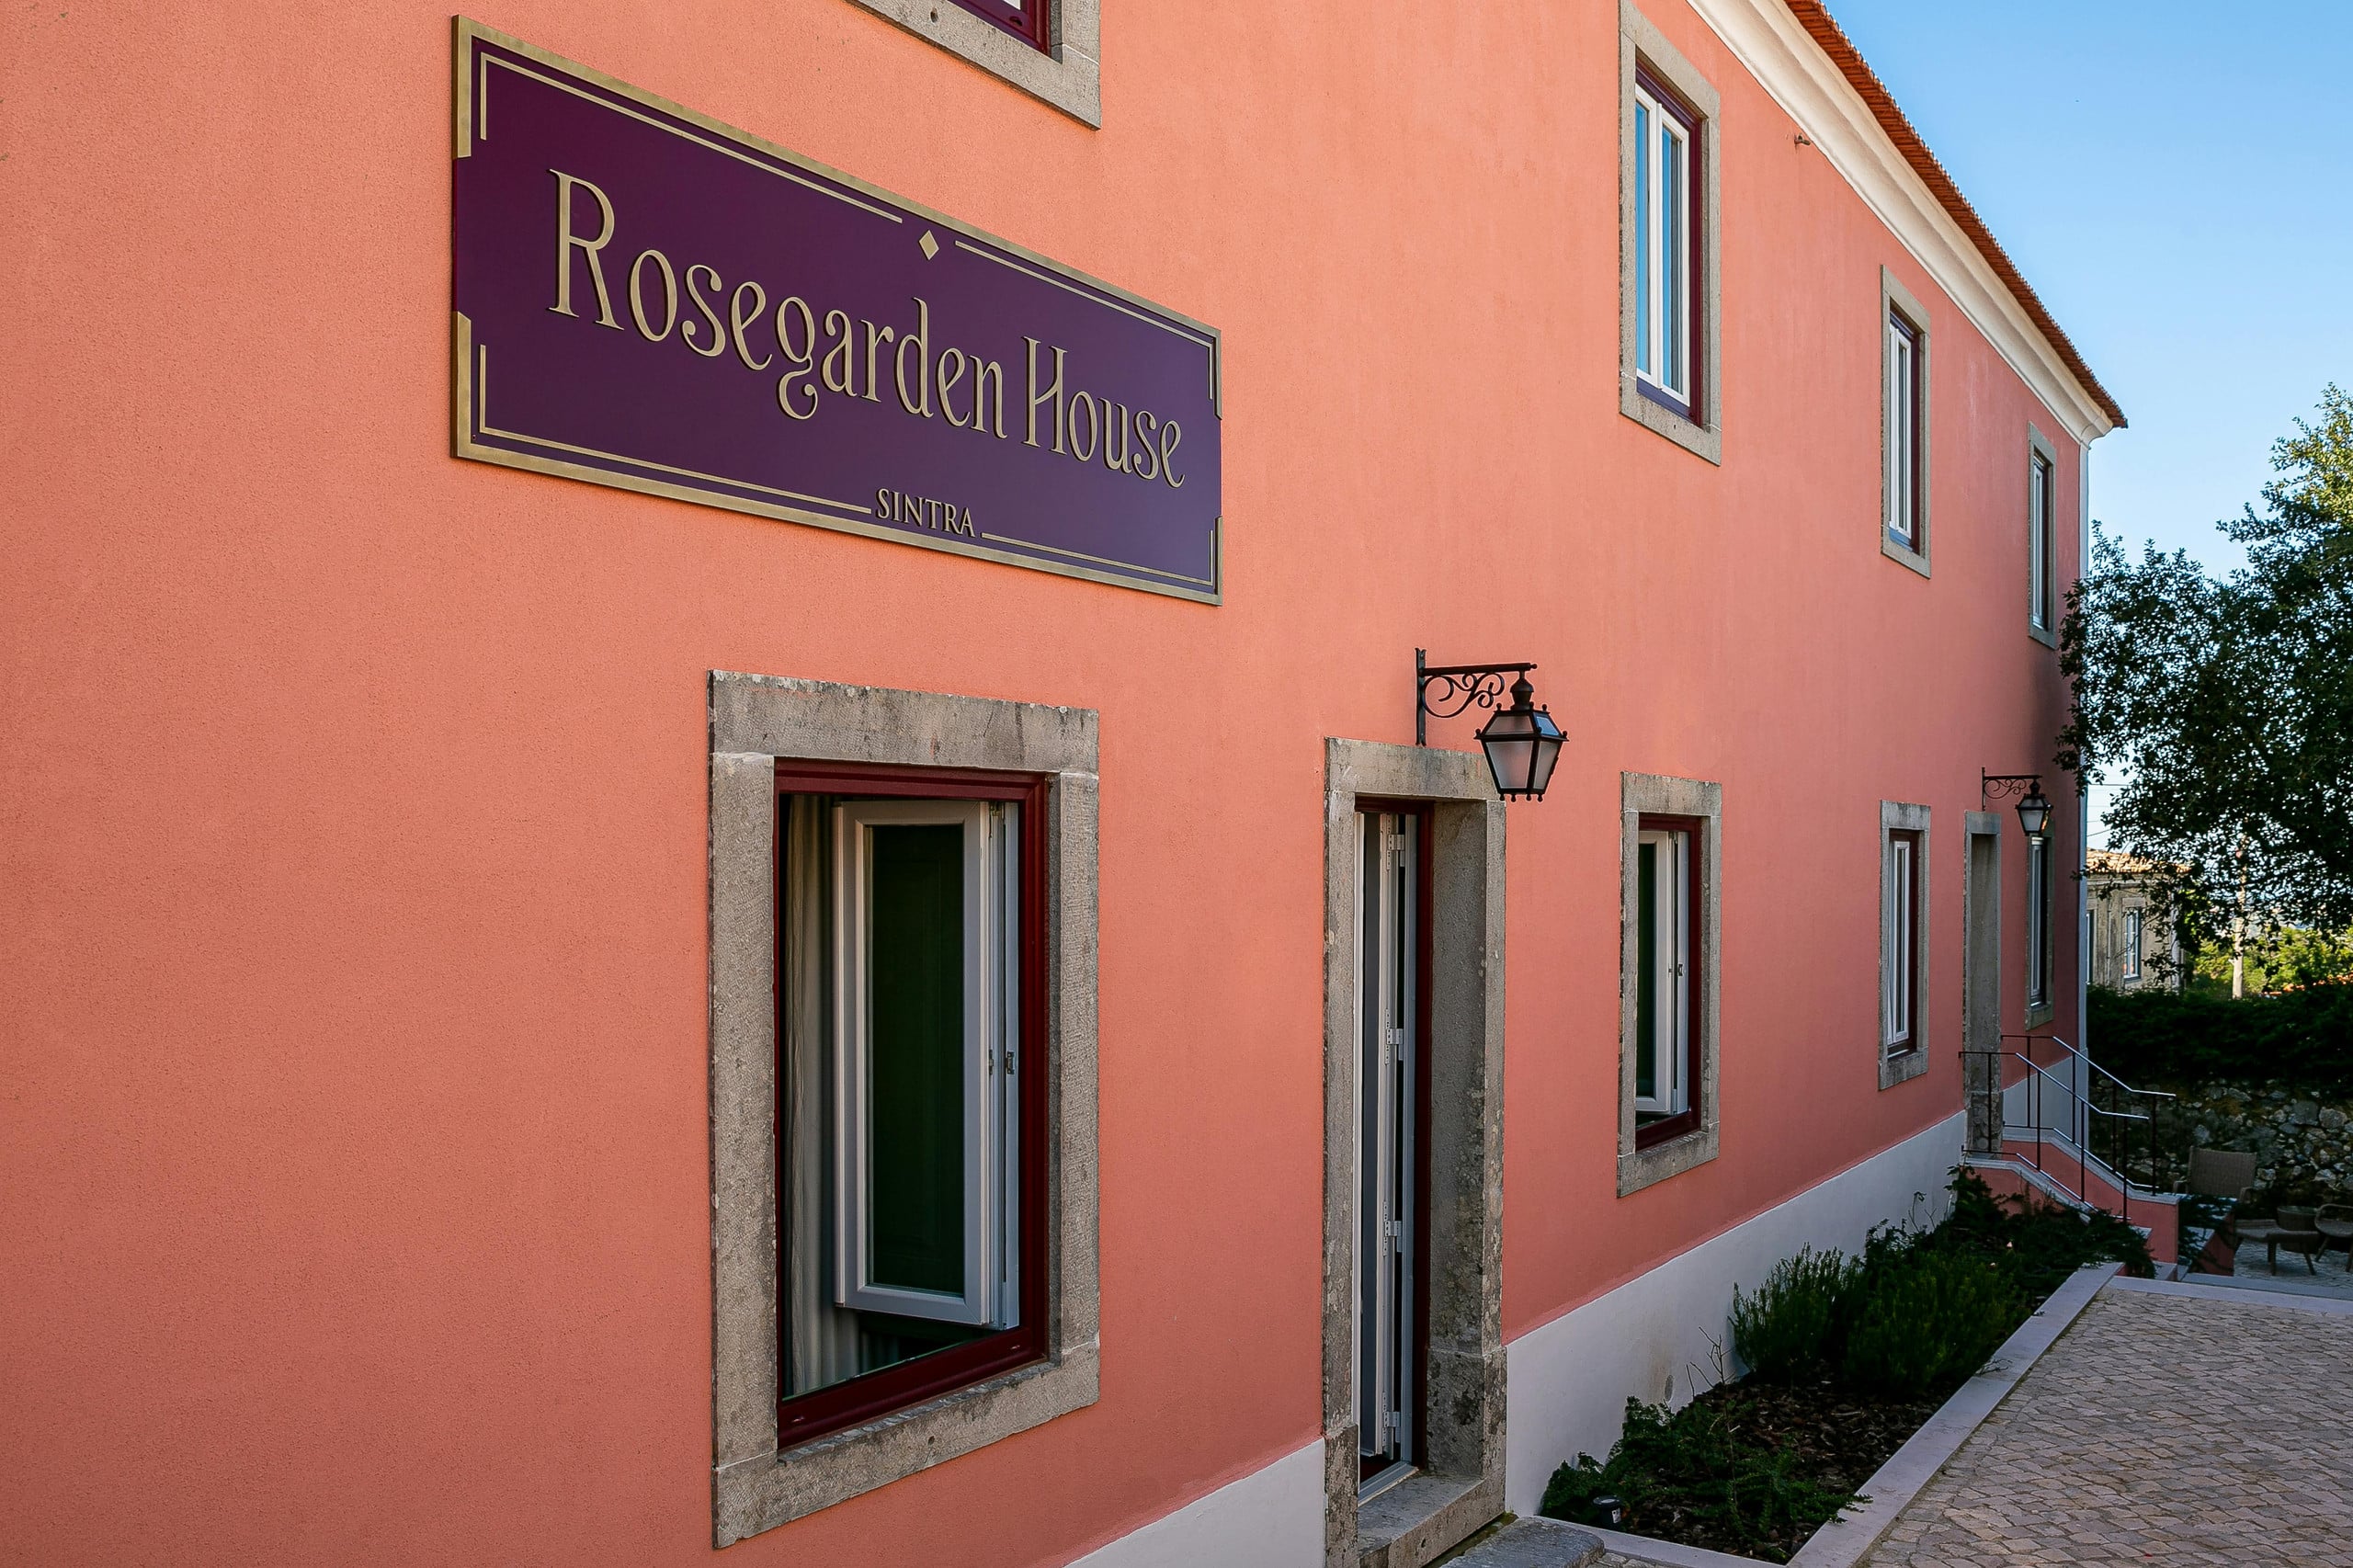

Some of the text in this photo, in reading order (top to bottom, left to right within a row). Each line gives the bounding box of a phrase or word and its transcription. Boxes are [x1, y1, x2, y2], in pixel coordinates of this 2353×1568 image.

[549, 169, 1186, 488] Rosegarden House
[876, 489, 976, 538] SINTRA
